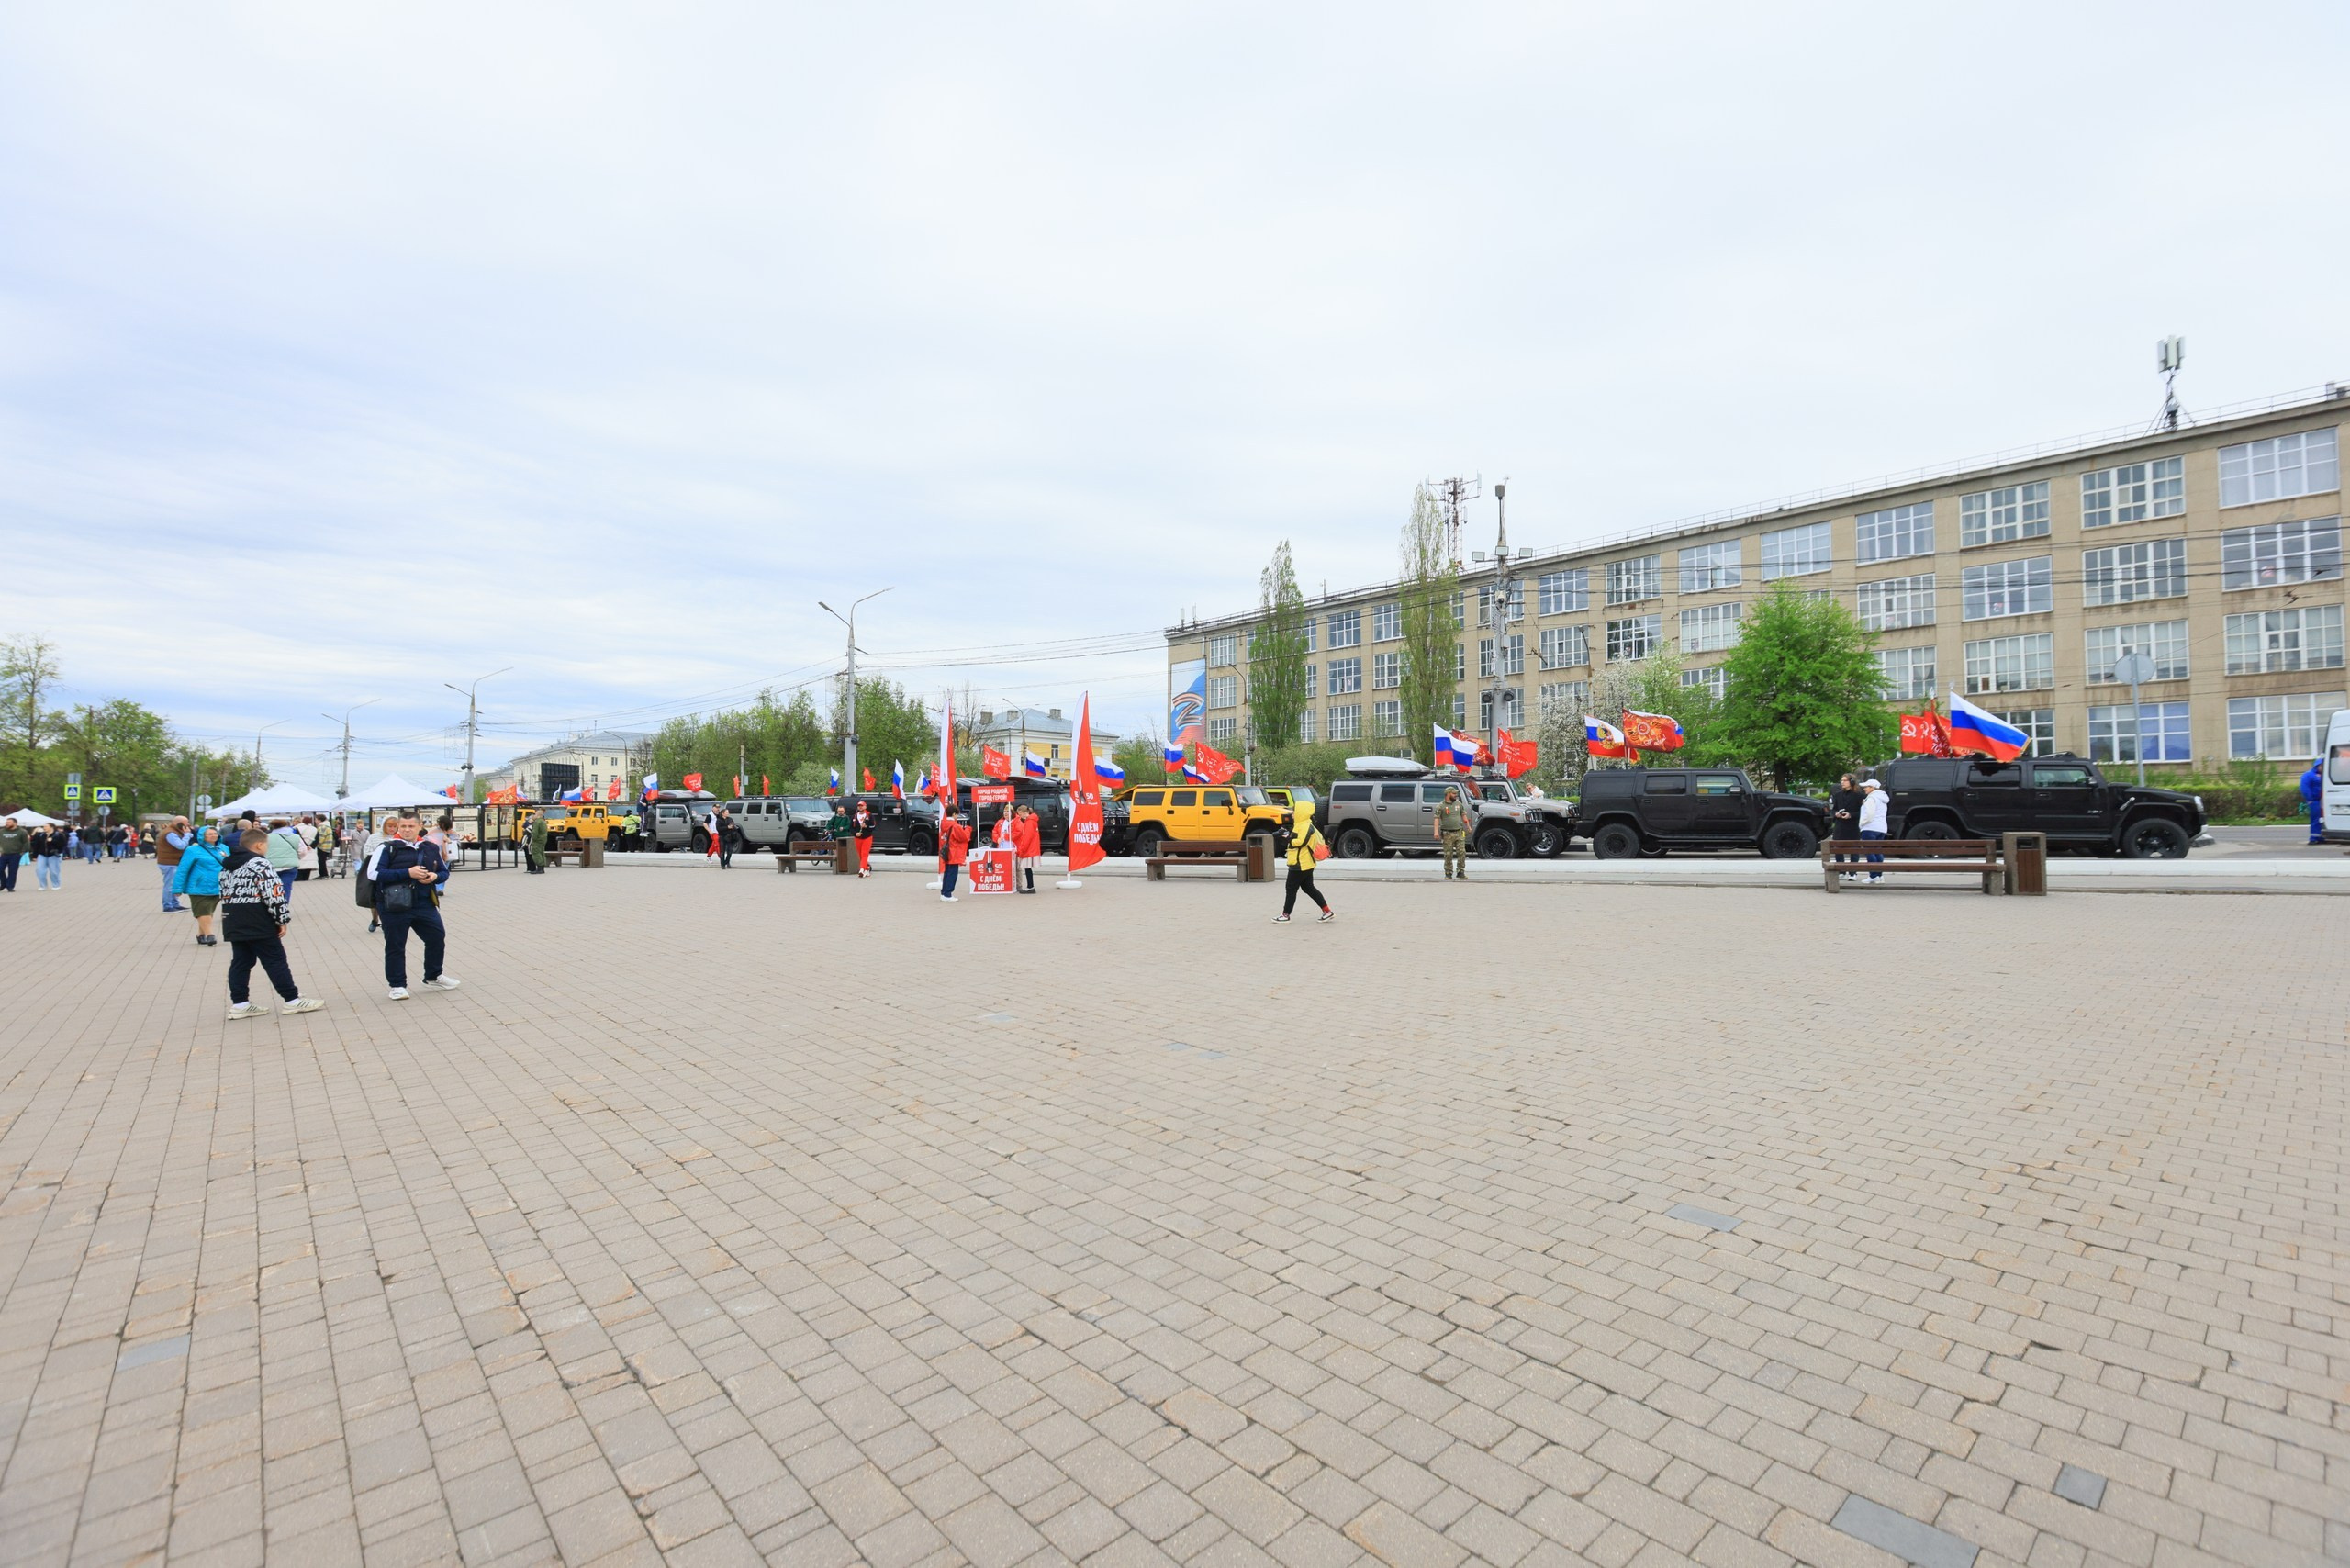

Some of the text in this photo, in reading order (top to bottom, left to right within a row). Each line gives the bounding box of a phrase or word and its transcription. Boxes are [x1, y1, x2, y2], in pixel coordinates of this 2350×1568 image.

[1080, 821, 1099, 834] ДНЁМ
[984, 874, 1002, 883] ДНЁМ
[977, 883, 1005, 891] ПОБЕДЫ!
